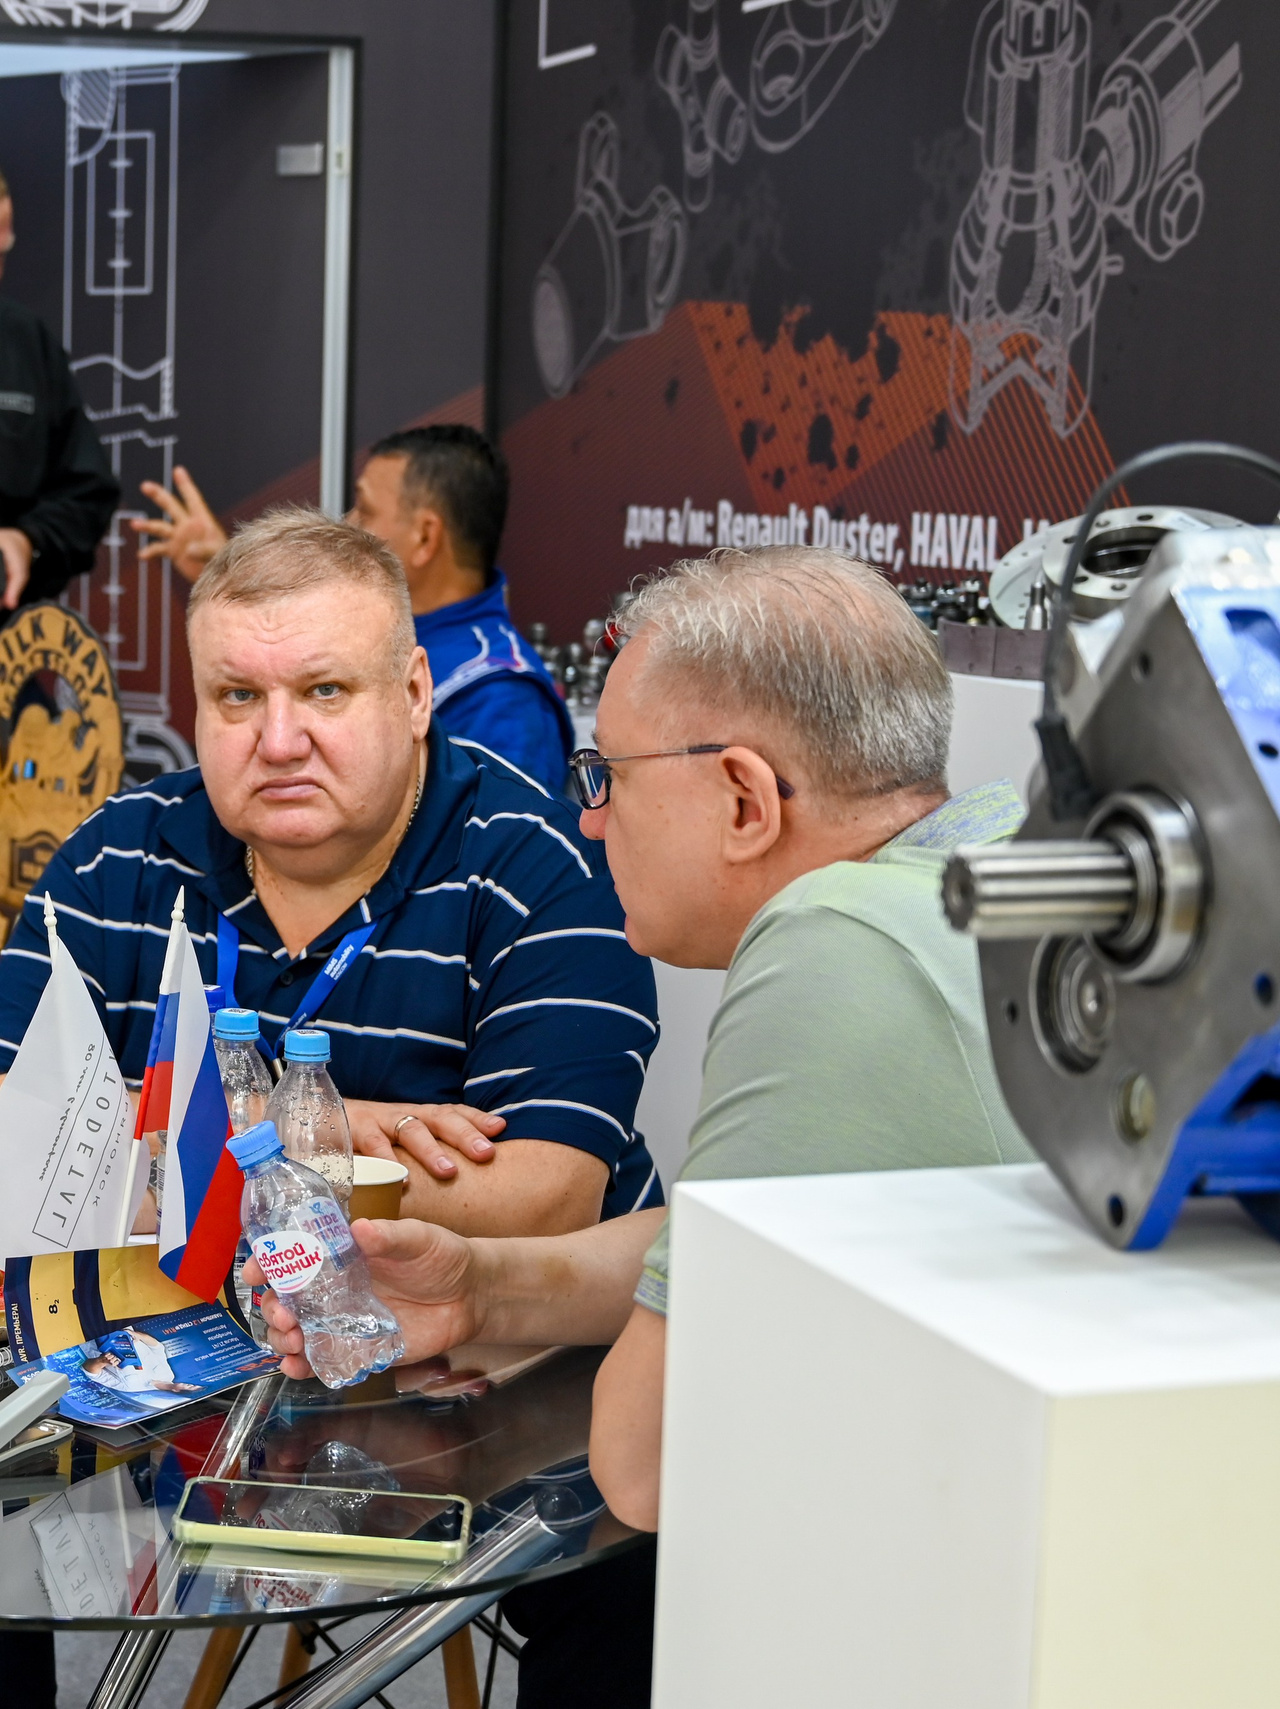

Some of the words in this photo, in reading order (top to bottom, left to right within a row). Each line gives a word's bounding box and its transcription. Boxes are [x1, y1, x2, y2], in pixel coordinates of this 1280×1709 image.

[716, 499, 809, 547] Renault
[813, 504, 903, 574] Duster,
[61, 619, 108, 697] WAY
[329, 943, 355, 979] automobility
[258, 1242, 306, 1268] СВЯТОЙ
[264, 1251, 322, 1280] СТОЧНИК
[11, 1303, 24, 1345] ПРЕМЬЕРА!
[199, 1312, 223, 1323] ПАВИЛЬОН
[207, 1330, 233, 1341] Антифризы
[17, 1345, 29, 1364] AVR.
